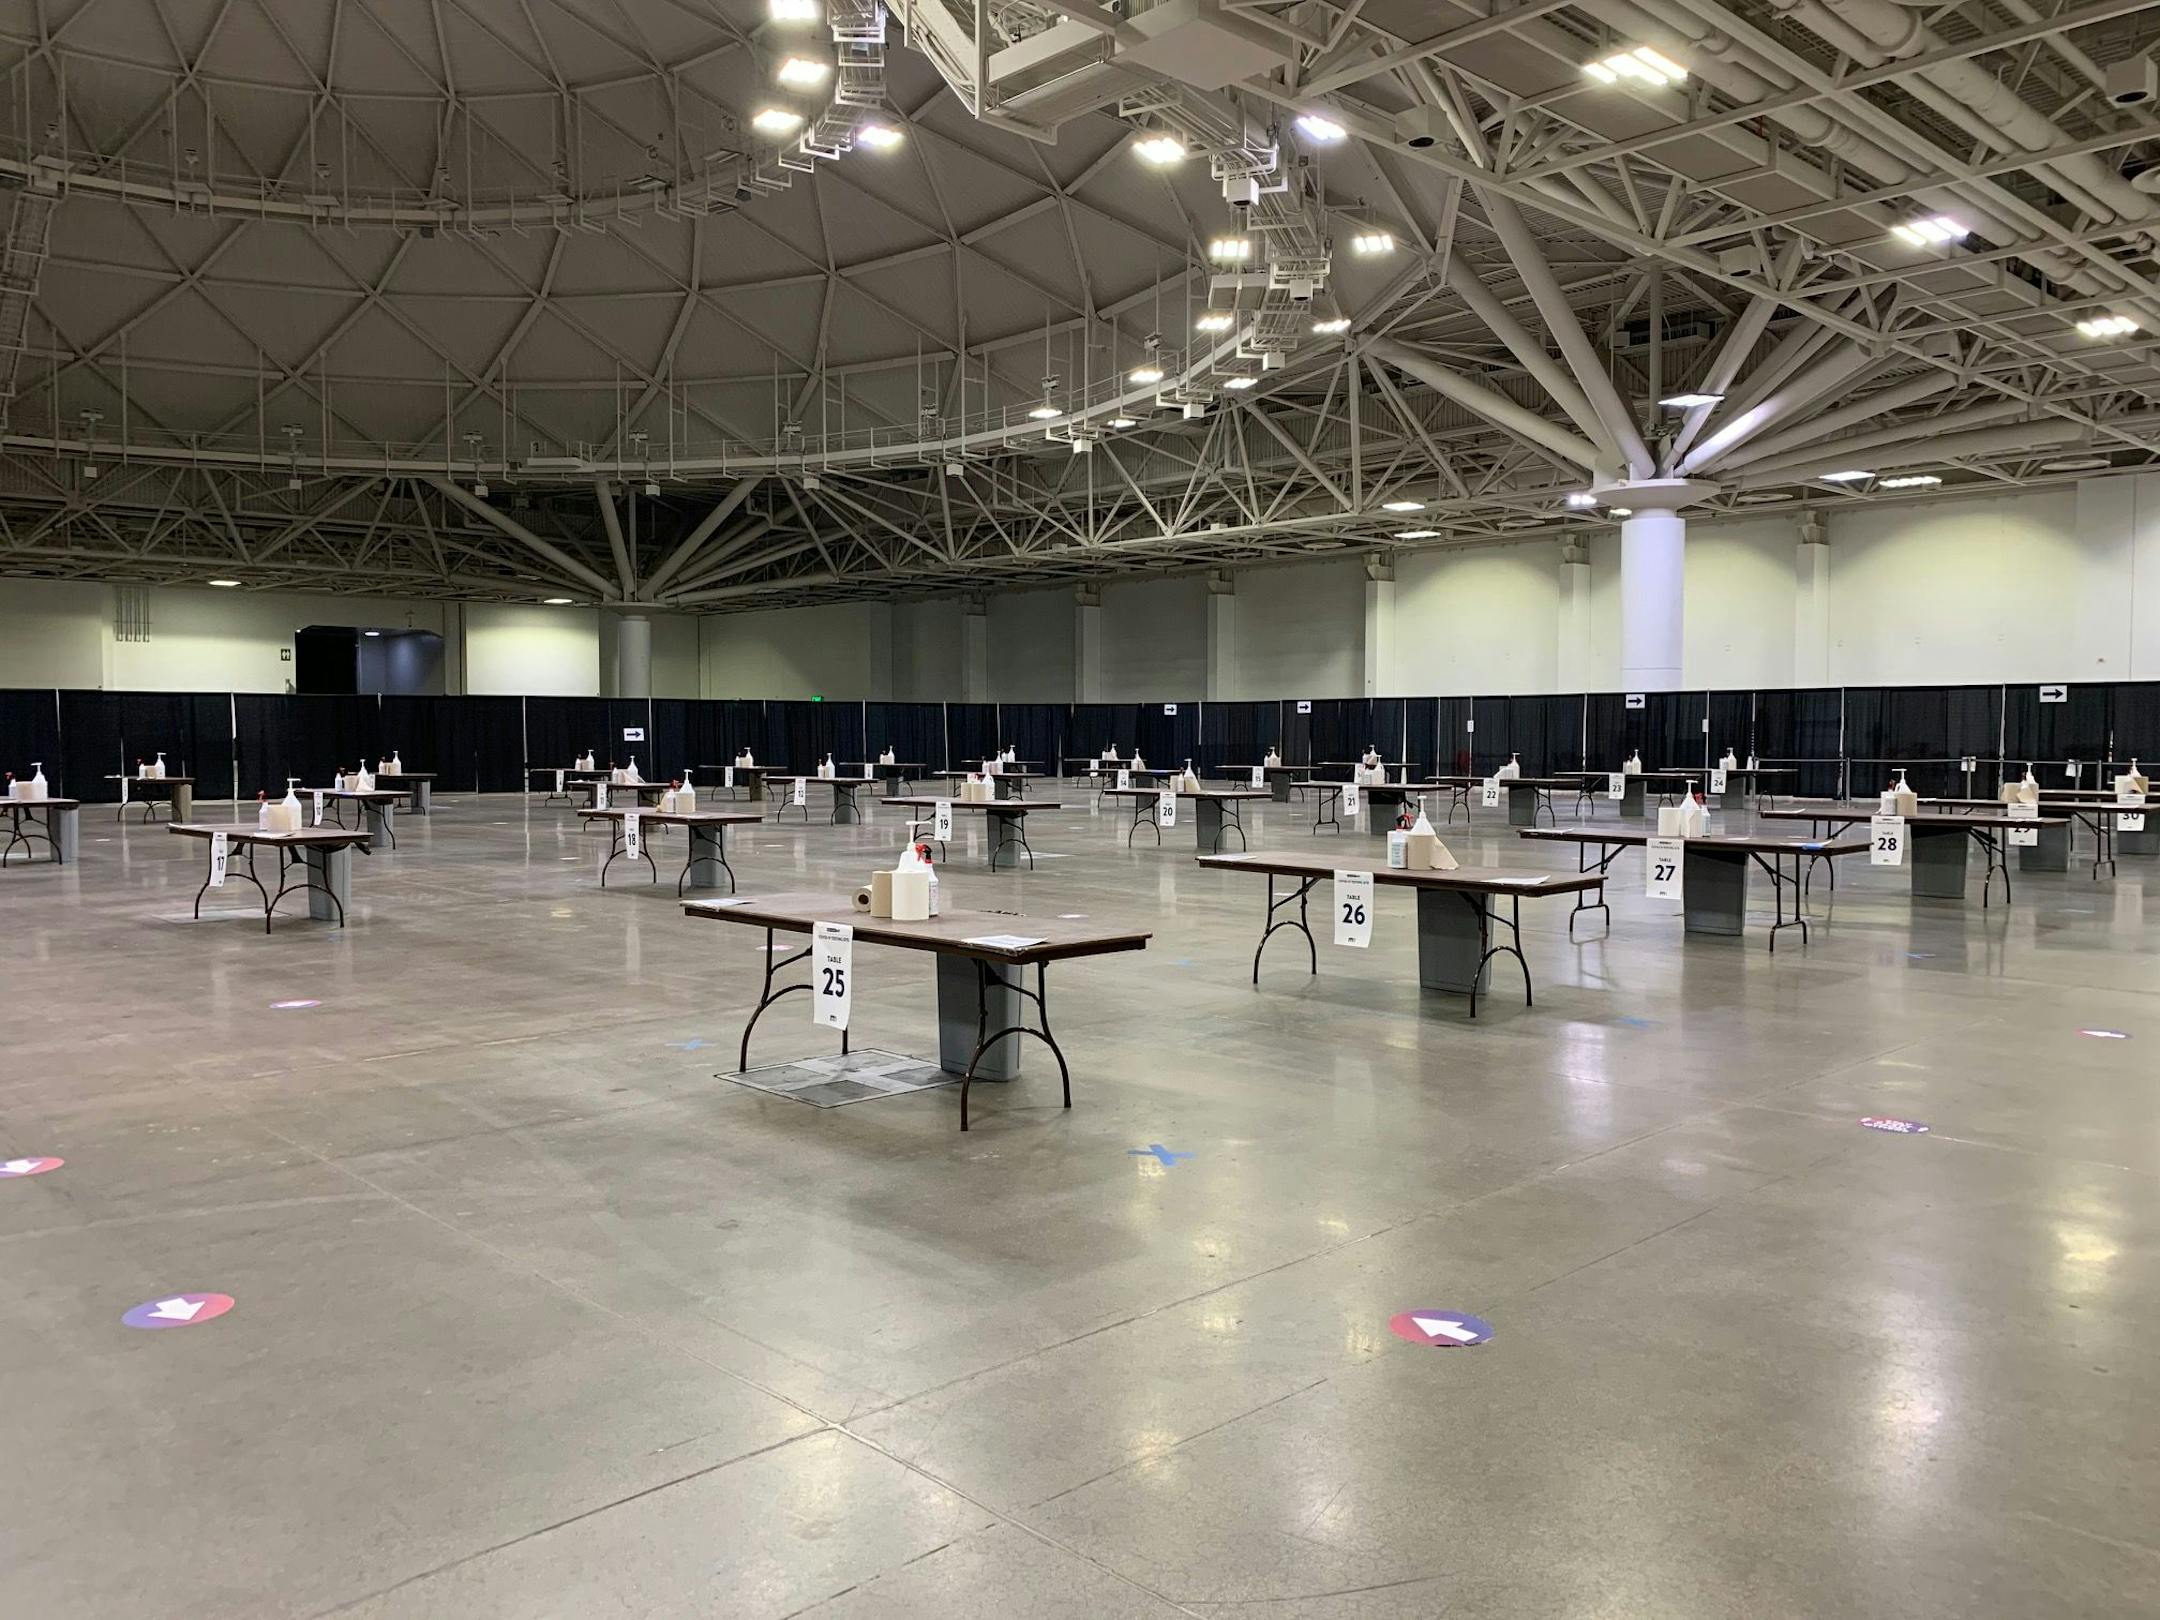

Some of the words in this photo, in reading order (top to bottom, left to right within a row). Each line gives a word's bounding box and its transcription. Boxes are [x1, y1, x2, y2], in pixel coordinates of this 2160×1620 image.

[1612, 784, 1622, 793] 23
[1714, 779, 1724, 787] 24
[1487, 790, 1497, 799] 22
[1348, 797, 1356, 806] 21
[1163, 807, 1173, 817] 20
[940, 818, 949, 830] 19
[628, 833, 636, 846] 18
[1878, 837, 1897, 851] 28
[217, 855, 225, 871] 17
[1654, 864, 1676, 881] 27
[1342, 903, 1366, 925] 26
[827, 955, 842, 964] TABLE
[822, 967, 845, 998] 25
